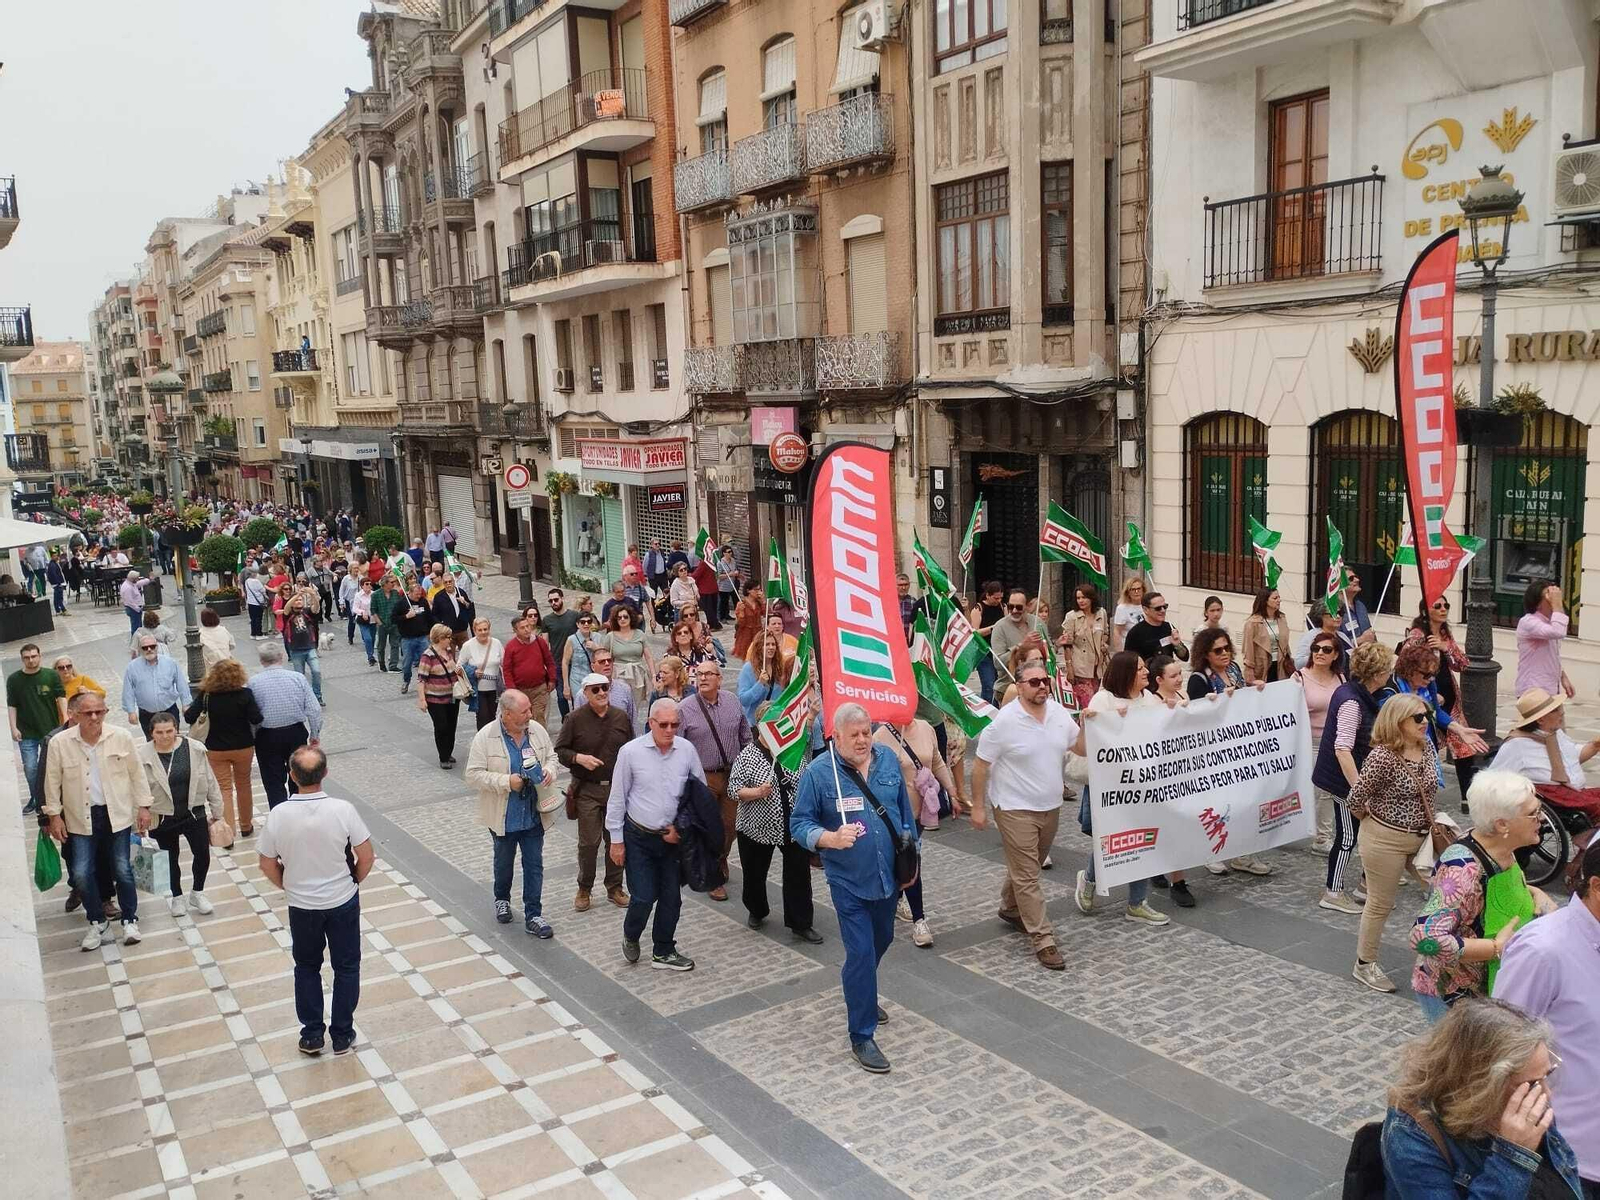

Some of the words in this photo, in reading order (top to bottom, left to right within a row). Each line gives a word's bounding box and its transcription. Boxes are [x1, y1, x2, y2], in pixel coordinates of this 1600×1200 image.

[1404, 218, 1432, 237] DE
[1408, 282, 1447, 498] CCOO
[621, 447, 642, 469] JAVIER
[644, 444, 683, 453] OPORTUNIDADES
[646, 451, 684, 464] JAVIER
[776, 447, 805, 456] Mahou
[653, 493, 682, 503] JAVIER
[1044, 528, 1091, 560] CCOO
[835, 681, 908, 706] Servicios
[1097, 746, 1139, 763] CONTRA
[1139, 742, 1160, 760] LOS
[1161, 734, 1197, 756] RECORTES
[1197, 731, 1207, 747] EN
[1206, 730, 1217, 745] LA
[1217, 722, 1255, 742] SANIDAD
[1255, 713, 1297, 734] PÚBLICA
[1120, 769, 1136, 784] EL
[1139, 766, 1157, 783] SAS
[1158, 758, 1192, 780] RECORTA
[1192, 754, 1206, 771] SUS
[1206, 737, 1281, 767] CONTRATACIONES
[1102, 789, 1142, 808] MENOS
[1144, 776, 1211, 803] PROFESIONALES
[1210, 770, 1235, 789] PEOR
[1234, 765, 1259, 783] PARA
[1258, 761, 1270, 776] TU
[1112, 832, 1145, 850] CCOO
